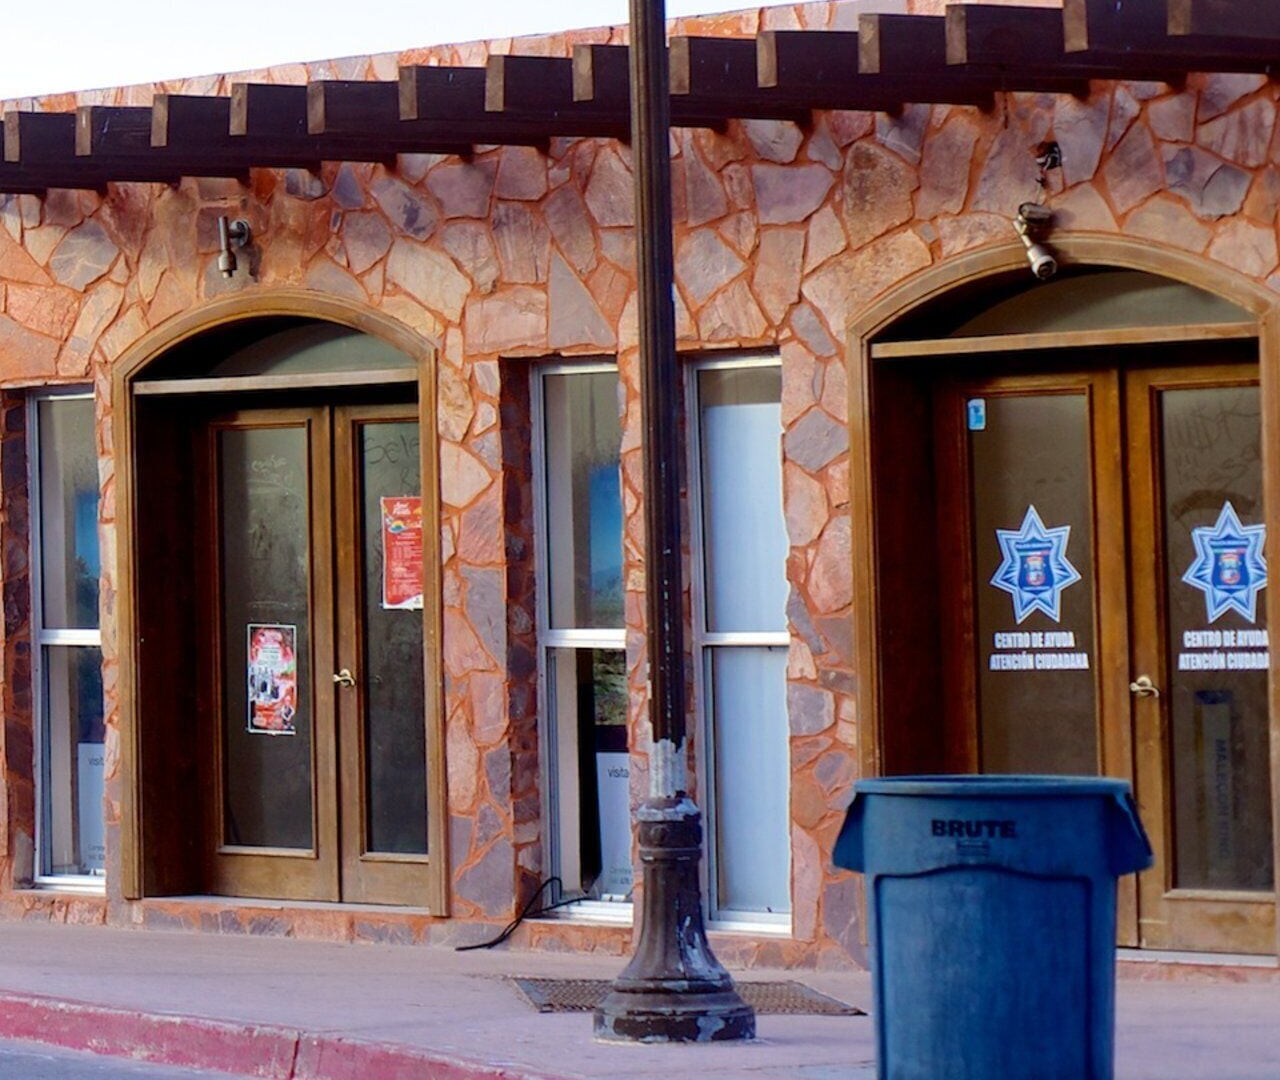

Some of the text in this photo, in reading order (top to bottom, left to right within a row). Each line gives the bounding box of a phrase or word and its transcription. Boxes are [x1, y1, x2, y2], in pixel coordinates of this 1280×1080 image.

[994, 631, 1076, 649] CENTRO DE AYUDA
[1183, 630, 1222, 648] CENTRO
[1222, 630, 1237, 647] DE
[989, 651, 1090, 670] ATENCIÓN CIUDADANA
[1178, 649, 1270, 670] ATENCIÓN CIUDADA
[931, 819, 1017, 839] BRUTE
